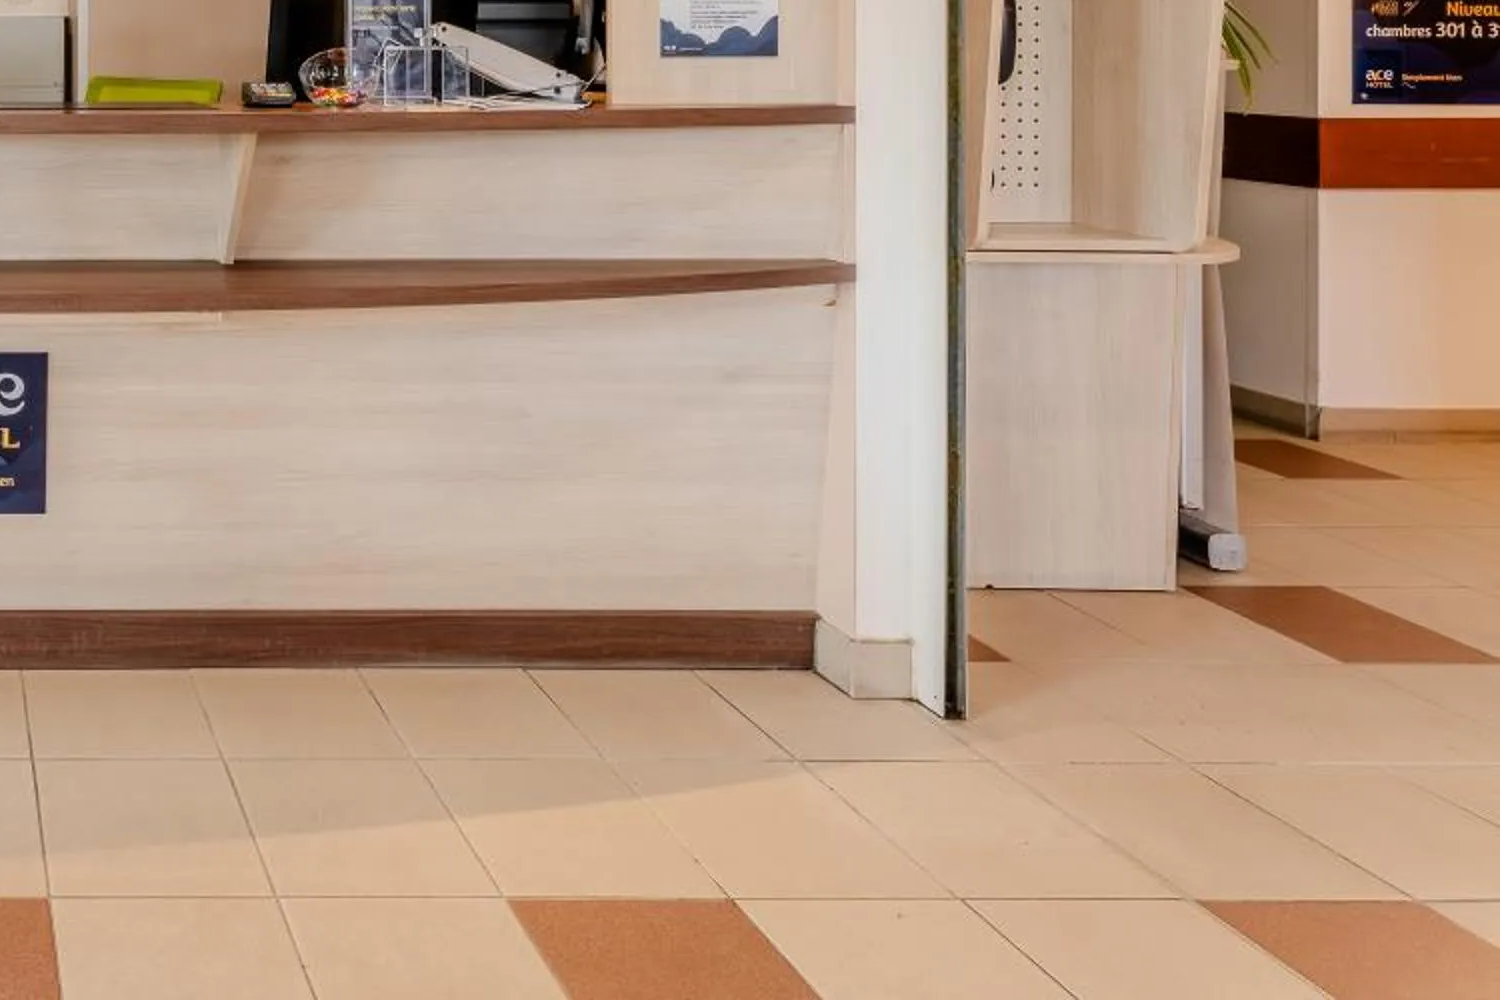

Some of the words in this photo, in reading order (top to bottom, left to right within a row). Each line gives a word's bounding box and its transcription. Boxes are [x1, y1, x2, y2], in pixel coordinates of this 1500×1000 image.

[1365, 24, 1432, 38] chambres
[1435, 22, 1465, 38] 301
[1471, 20, 1483, 38] à
[1365, 68, 1395, 81] ace
